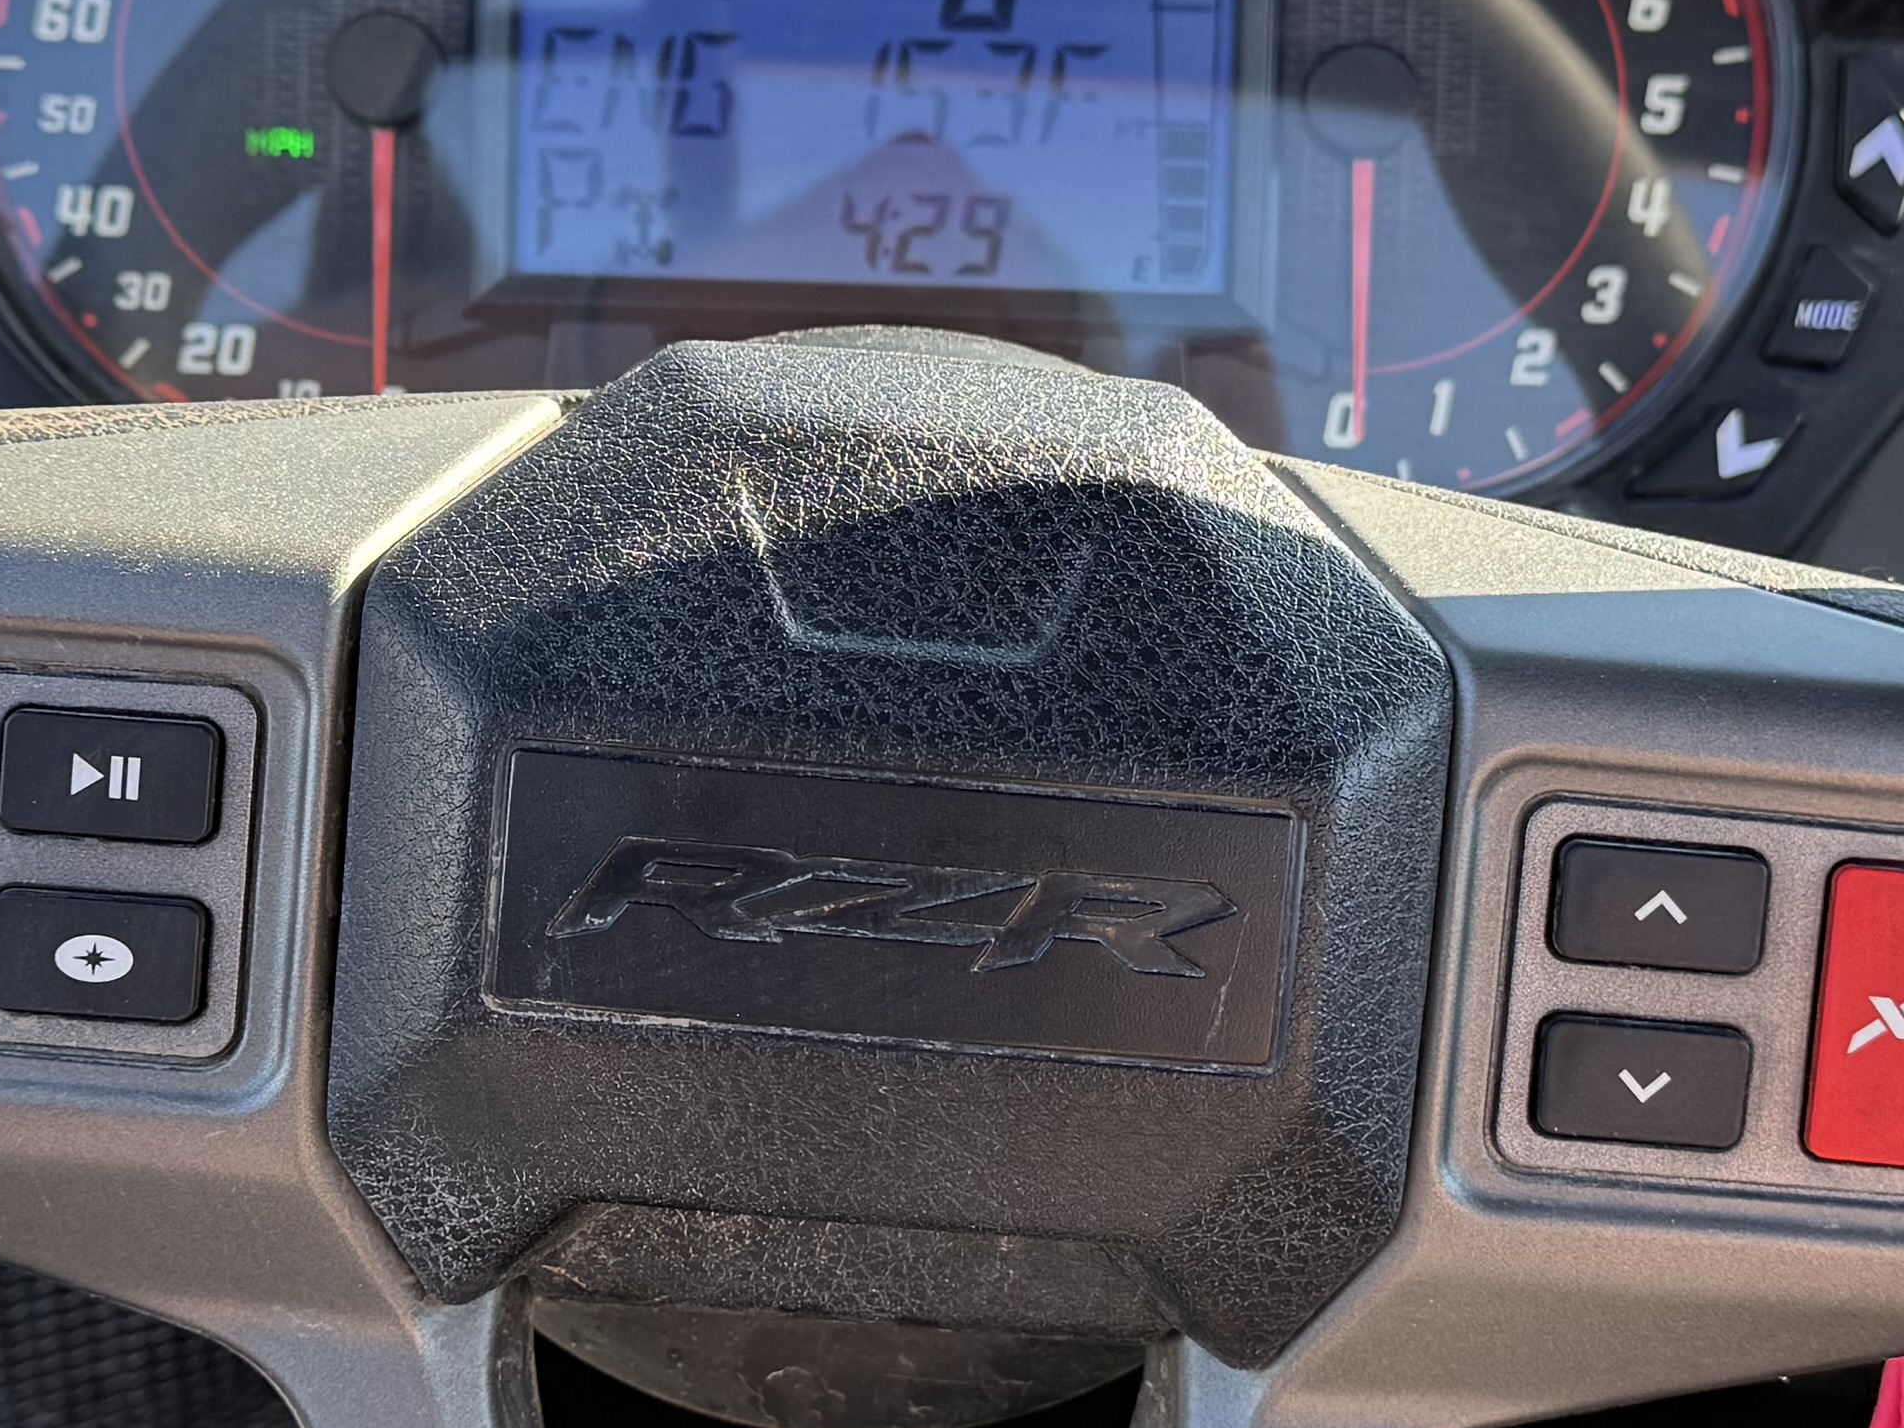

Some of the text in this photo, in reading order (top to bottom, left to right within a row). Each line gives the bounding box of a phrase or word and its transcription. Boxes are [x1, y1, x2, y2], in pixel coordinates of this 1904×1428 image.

[38, 95, 96, 134] 50
[1641, 75, 1688, 135] 5
[55, 184, 133, 238] 40
[840, 191, 1010, 276] 4:29
[1628, 178, 1672, 237] 4
[114, 272, 170, 311] 30
[1581, 264, 1627, 326] 3
[1793, 299, 1862, 333] MODE
[178, 323, 256, 375] 20
[1512, 327, 1557, 386] 2
[1324, 392, 1364, 448] 0
[1429, 379, 1456, 436] 1
[545, 835, 1240, 978] RZR
